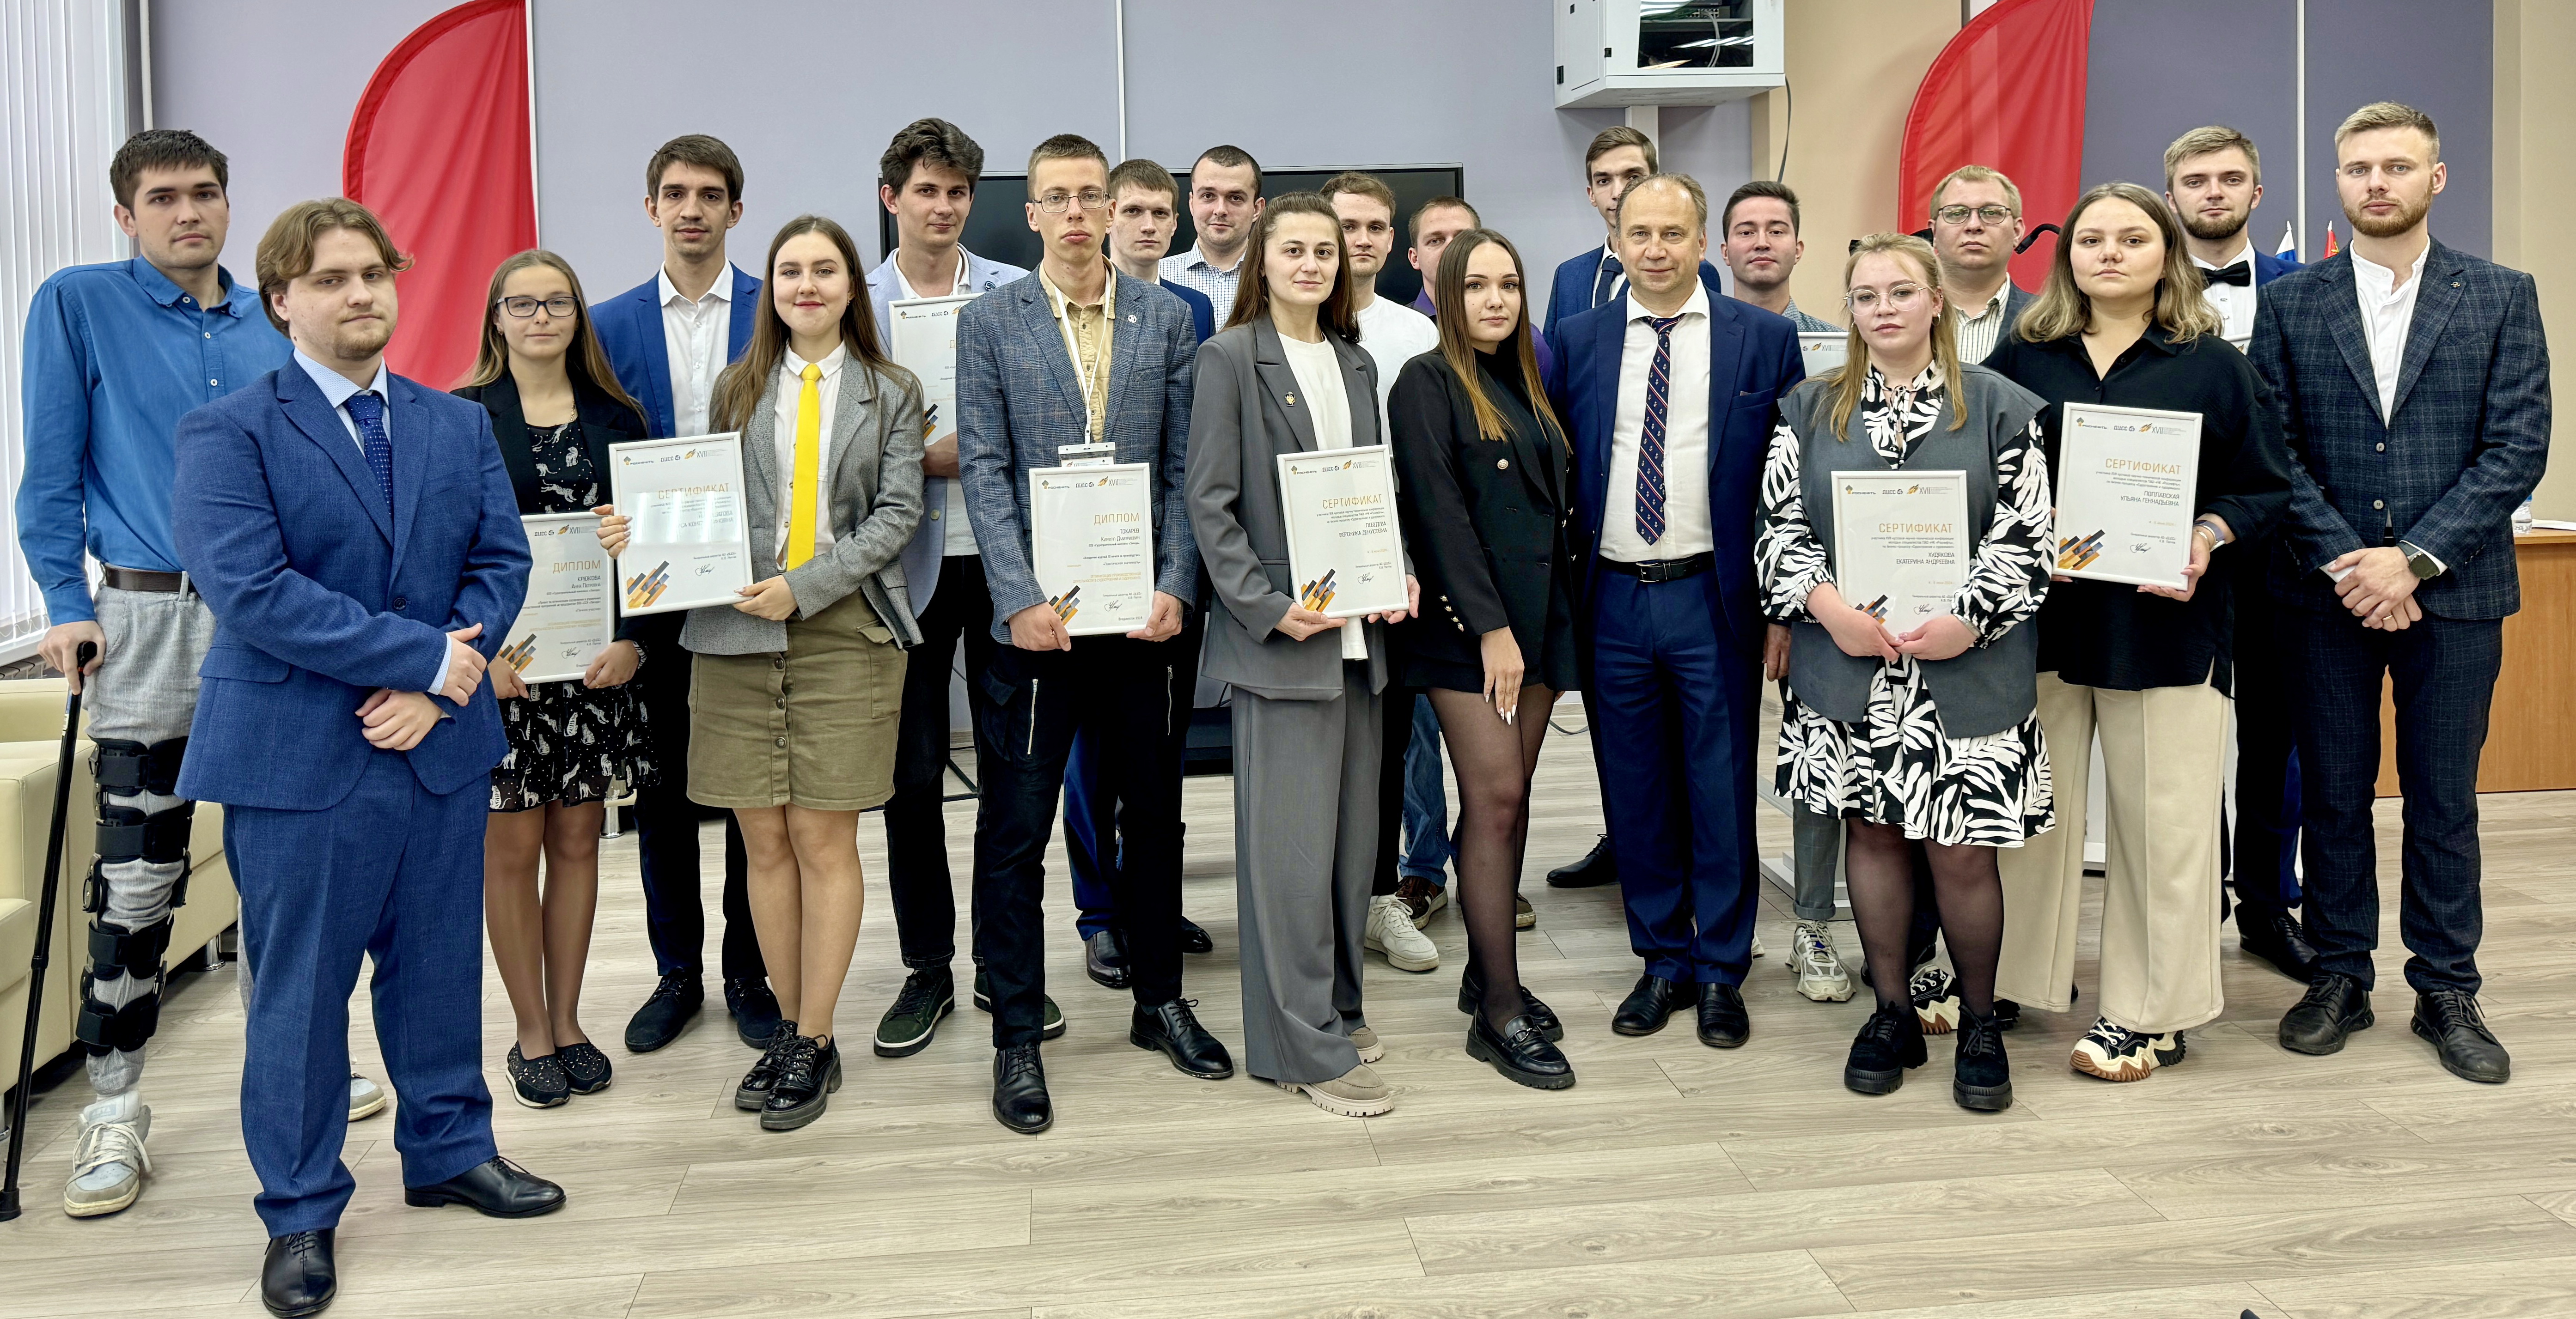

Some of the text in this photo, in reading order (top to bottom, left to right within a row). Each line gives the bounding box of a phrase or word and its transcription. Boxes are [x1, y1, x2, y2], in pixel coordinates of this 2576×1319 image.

[2106, 458, 2181, 474] СЕРТИФИКАТ
[1322, 494, 1382, 509] СЕРТИФИКАТ
[1094, 513, 1139, 525] ДИПЛОМ
[1879, 523, 1953, 533] СЕРТИФИКАТ
[553, 560, 600, 573] ДИПЛОМ
